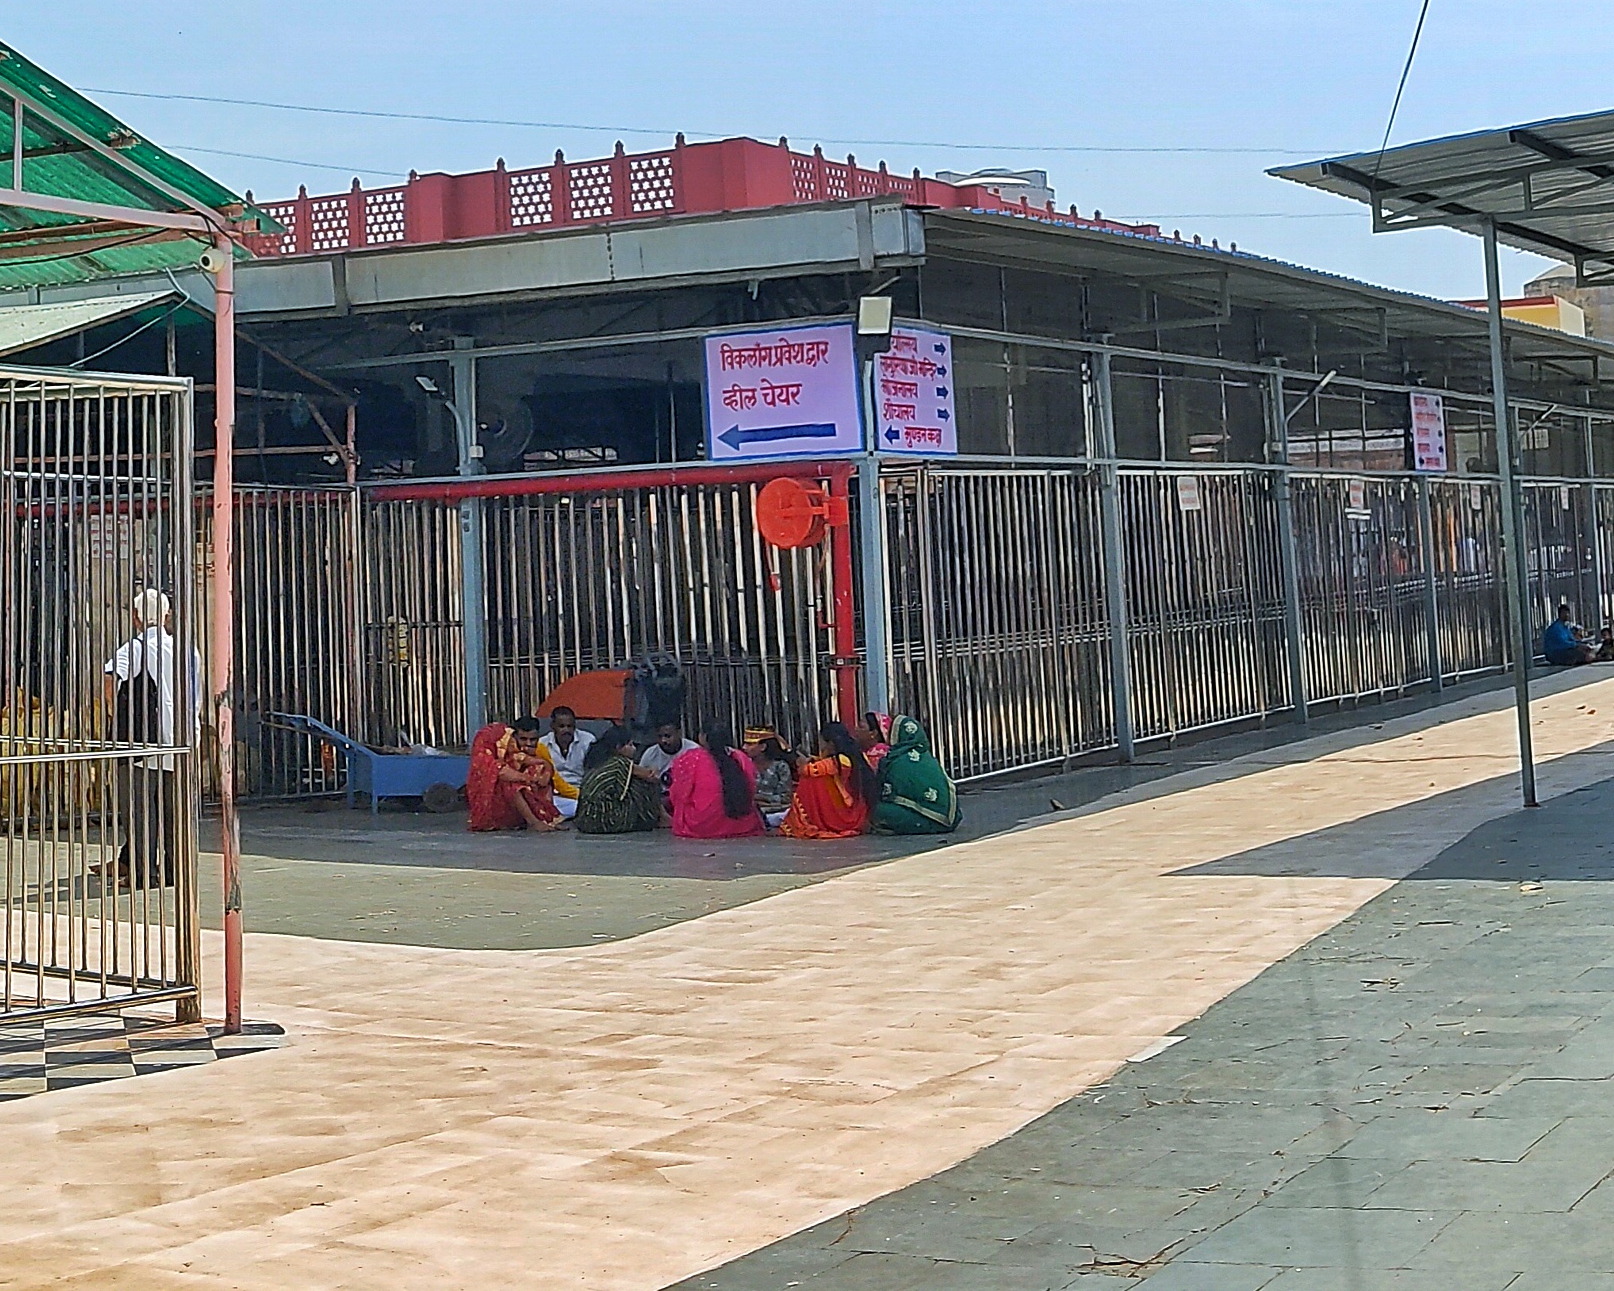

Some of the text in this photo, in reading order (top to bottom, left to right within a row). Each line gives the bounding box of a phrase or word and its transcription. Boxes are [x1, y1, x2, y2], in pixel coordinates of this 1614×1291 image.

[772, 337, 805, 367] प्रवेश
[805, 341, 830, 368] द्वार
[759, 378, 803, 408] चेयर
